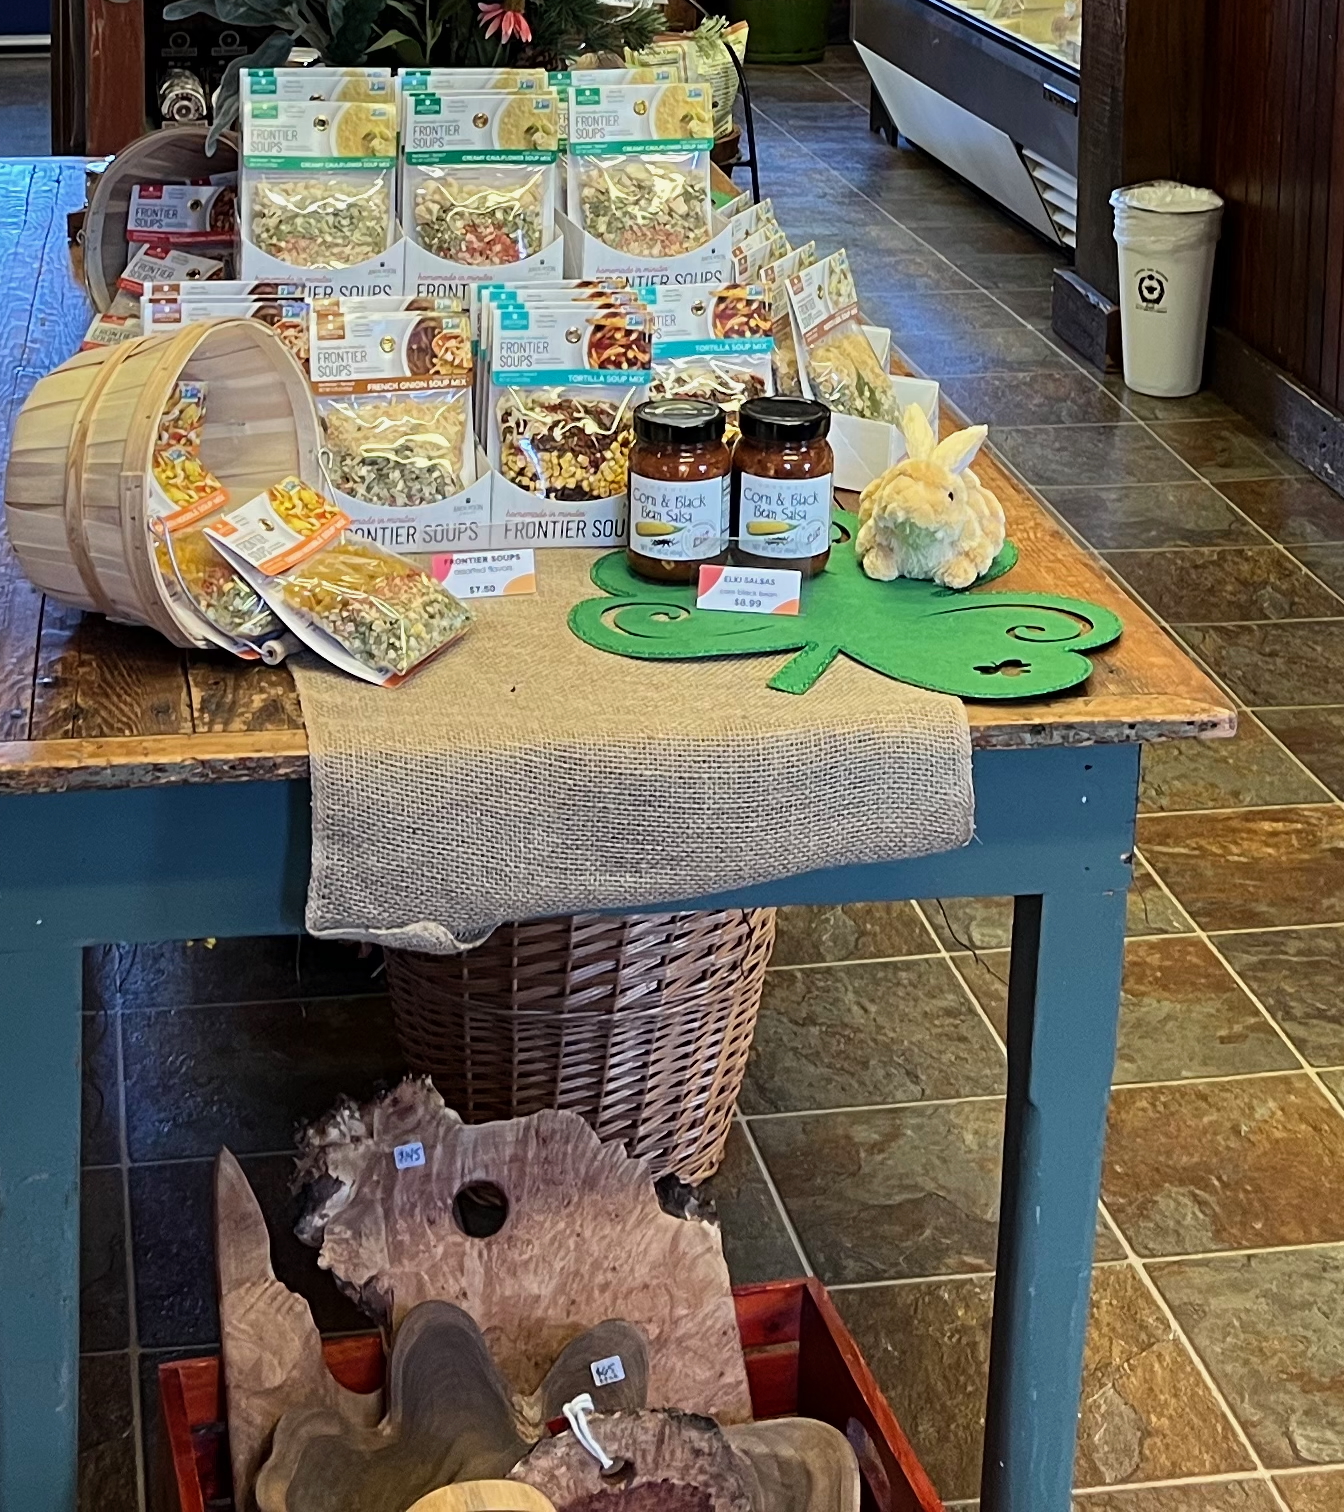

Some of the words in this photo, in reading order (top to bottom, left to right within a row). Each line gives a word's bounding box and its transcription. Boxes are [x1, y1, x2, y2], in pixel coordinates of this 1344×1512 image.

[575, 115, 619, 128] FRONTIER
[250, 129, 298, 142] FRONTIER
[413, 124, 460, 137] FRONTIER
[575, 128, 605, 139] SOUPS
[250, 142, 282, 153] SOUPS
[413, 138, 445, 149] SOUPS
[135, 207, 178, 219] FRONTIER
[135, 218, 164, 229] SOUPS
[417, 283, 468, 298] FRONT
[500, 341, 549, 354] FRONTIER
[695, 345, 730, 353] TORTILLA
[732, 343, 751, 352] SOUP
[753, 343, 767, 351] MIX
[317, 351, 367, 364] FRONTIER
[500, 355, 533, 368] SOUPS
[317, 365, 352, 378] SOUPS
[367, 382, 398, 392] FRENCH
[400, 381, 427, 390] ONION
[429, 380, 449, 389] SOUP
[451, 379, 467, 387] MIX
[568, 375, 604, 383] TORTILLA
[607, 375, 627, 383] SOUP
[629, 375, 644, 383] MIX
[633, 488, 656, 506] Corn
[661, 494, 670, 508] &
[675, 493, 706, 509] Black
[744, 488, 771, 506] Corn
[776, 493, 785, 506] &
[790, 491, 819, 506] Black
[641, 507, 661, 521] Bean
[666, 509, 693, 523] Salsa
[754, 506, 777, 520] Bean
[781, 507, 807, 521] Salsa
[423, 522, 479, 544] SOUPS
[506, 520, 586, 539] FRONTIER
[592, 518, 625, 539] SOU
[444, 556, 488, 565] FRONTIER
[492, 553, 521, 563] SOUPS
[743, 576, 776, 586] SALSAS
[734, 598, 762, 608] $8.99
